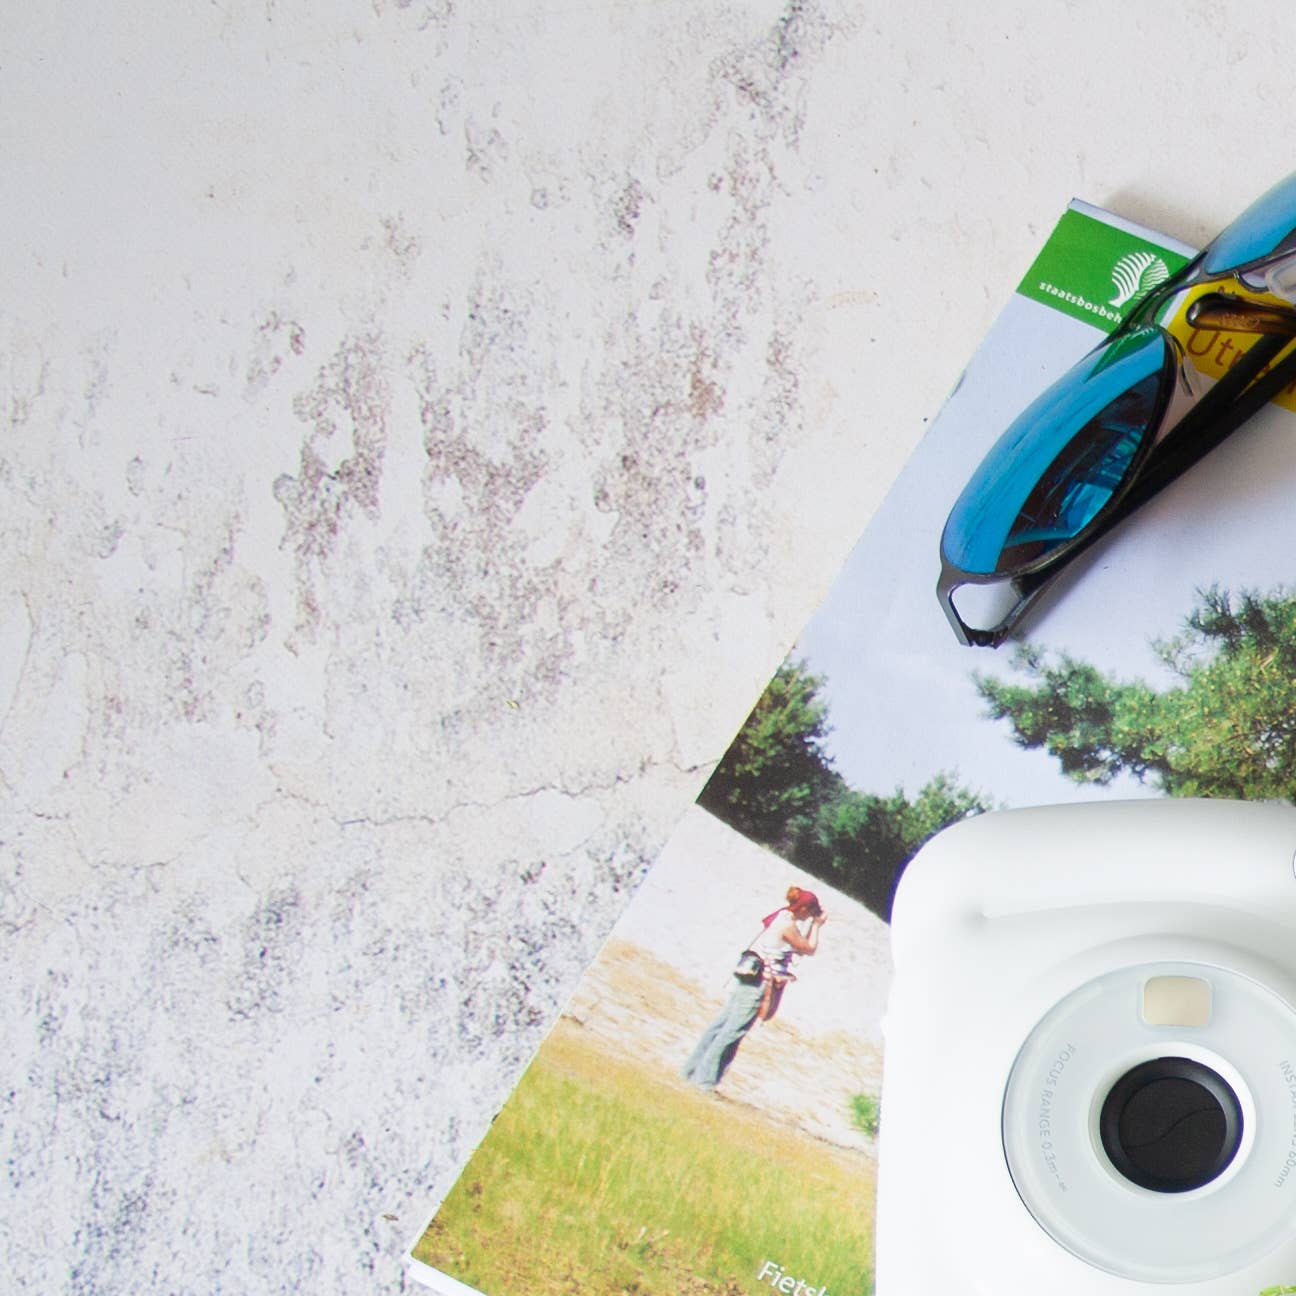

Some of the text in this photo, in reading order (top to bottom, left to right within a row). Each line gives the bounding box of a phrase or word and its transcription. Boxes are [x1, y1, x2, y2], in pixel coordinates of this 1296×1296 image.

[1039, 281, 1122, 324] staatsbosbeh
[1046, 1042, 1076, 1086] FOCUS
[1039, 1089, 1054, 1137] RANGE
